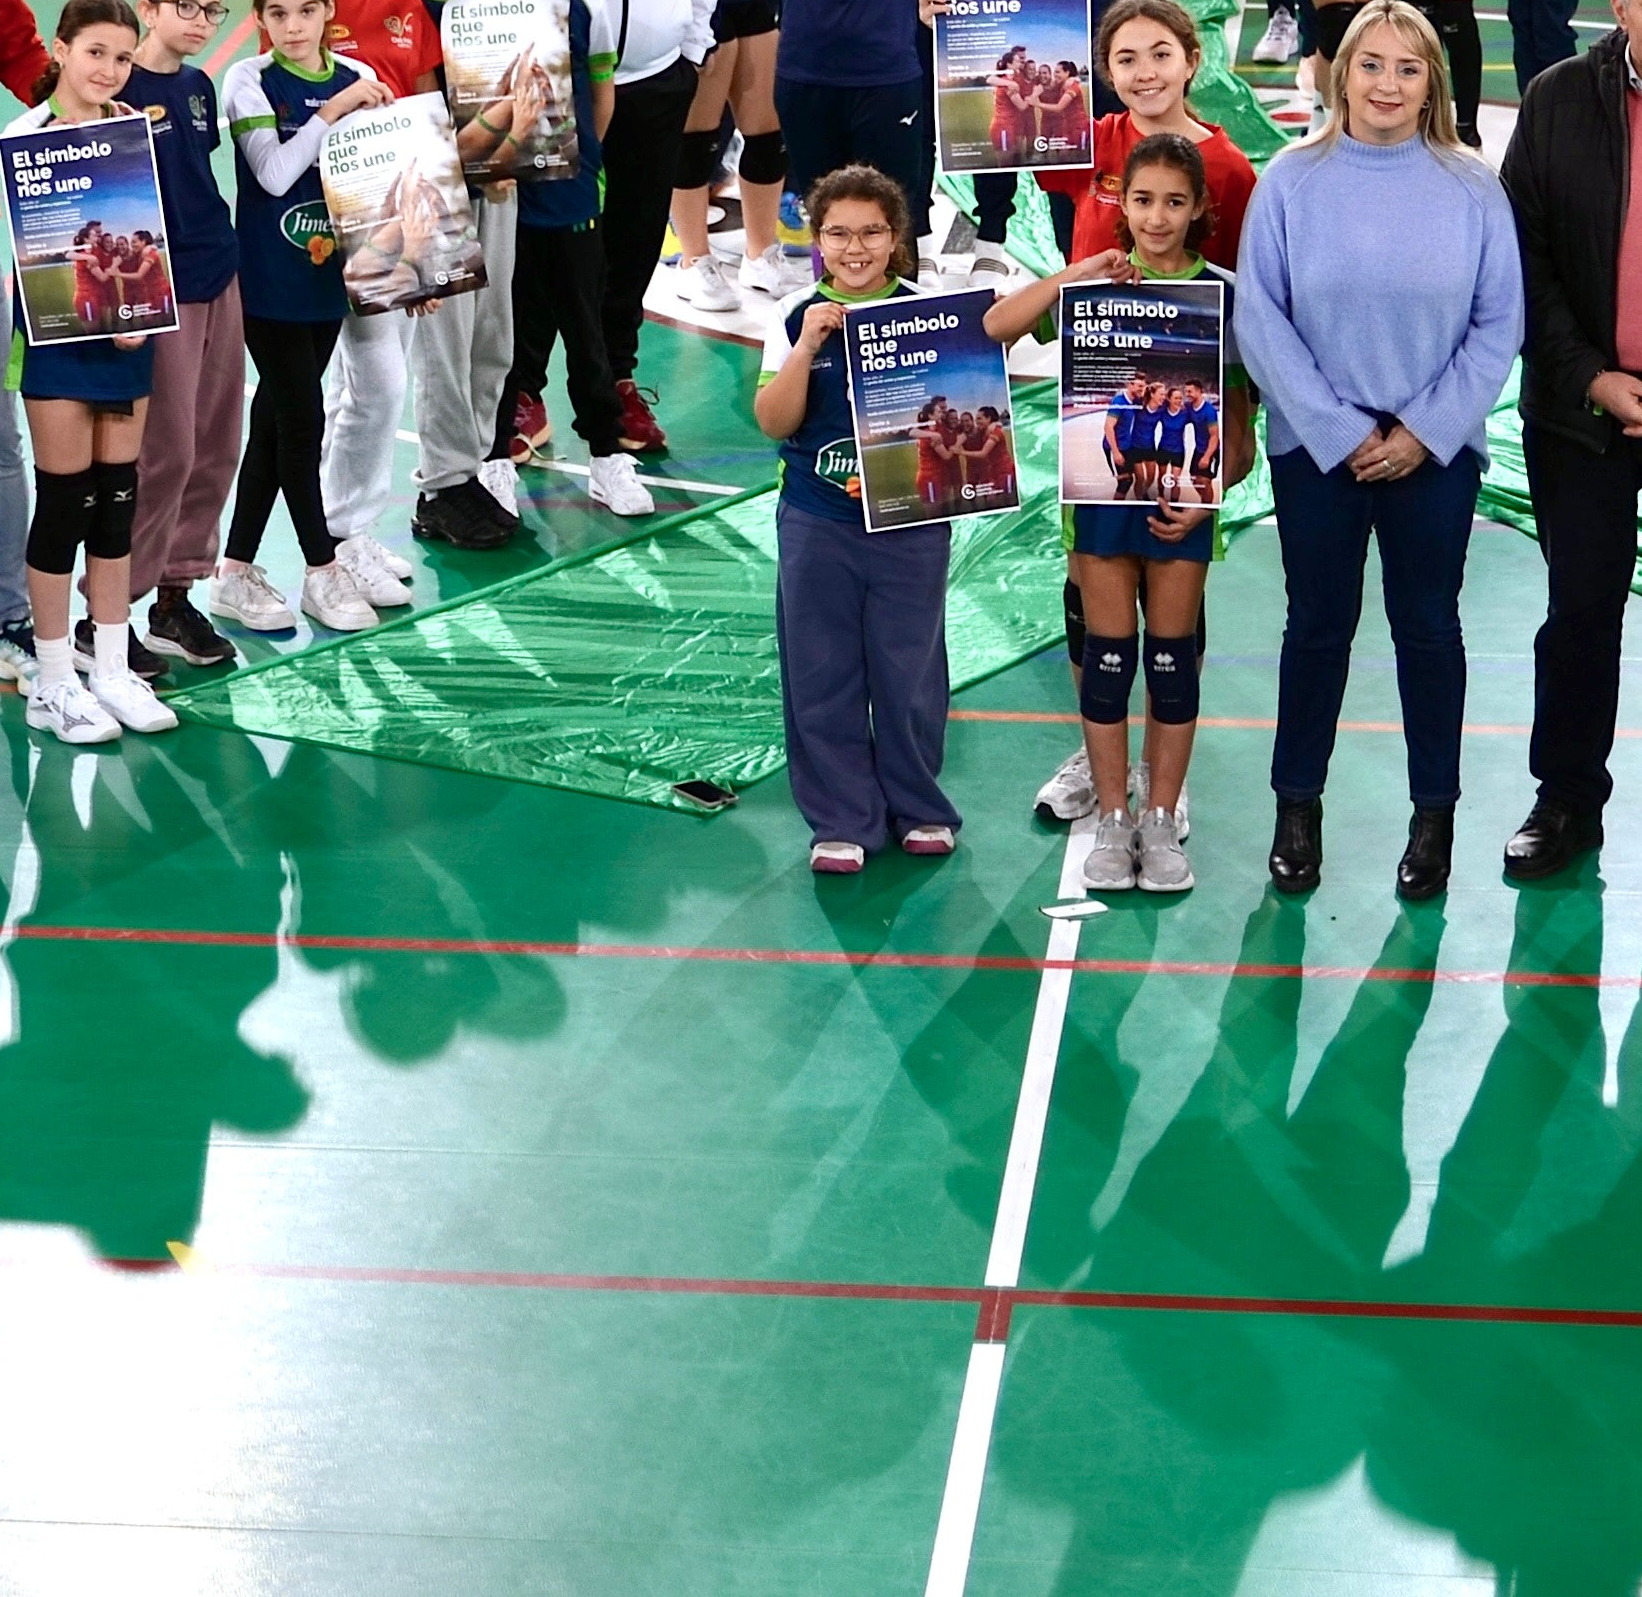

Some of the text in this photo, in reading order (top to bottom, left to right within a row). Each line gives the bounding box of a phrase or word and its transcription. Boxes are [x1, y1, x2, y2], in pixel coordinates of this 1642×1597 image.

[451, 0, 535, 20] El símbolo
[946, 0, 1022, 16] nos une
[451, 21, 484, 37] que
[452, 32, 517, 48] nos une
[328, 115, 412, 148] El símbolo
[12, 140, 112, 169] El símbolo
[328, 144, 359, 164] que
[329, 150, 396, 176] nos une
[14, 166, 53, 186] que
[17, 175, 93, 198] nos une
[1073, 299, 1179, 318] El símbolo
[858, 312, 960, 342] El símbolo
[1073, 318, 1113, 336] que
[859, 339, 898, 360] que
[1073, 334, 1153, 349] nos une
[861, 349, 938, 373] nos une
